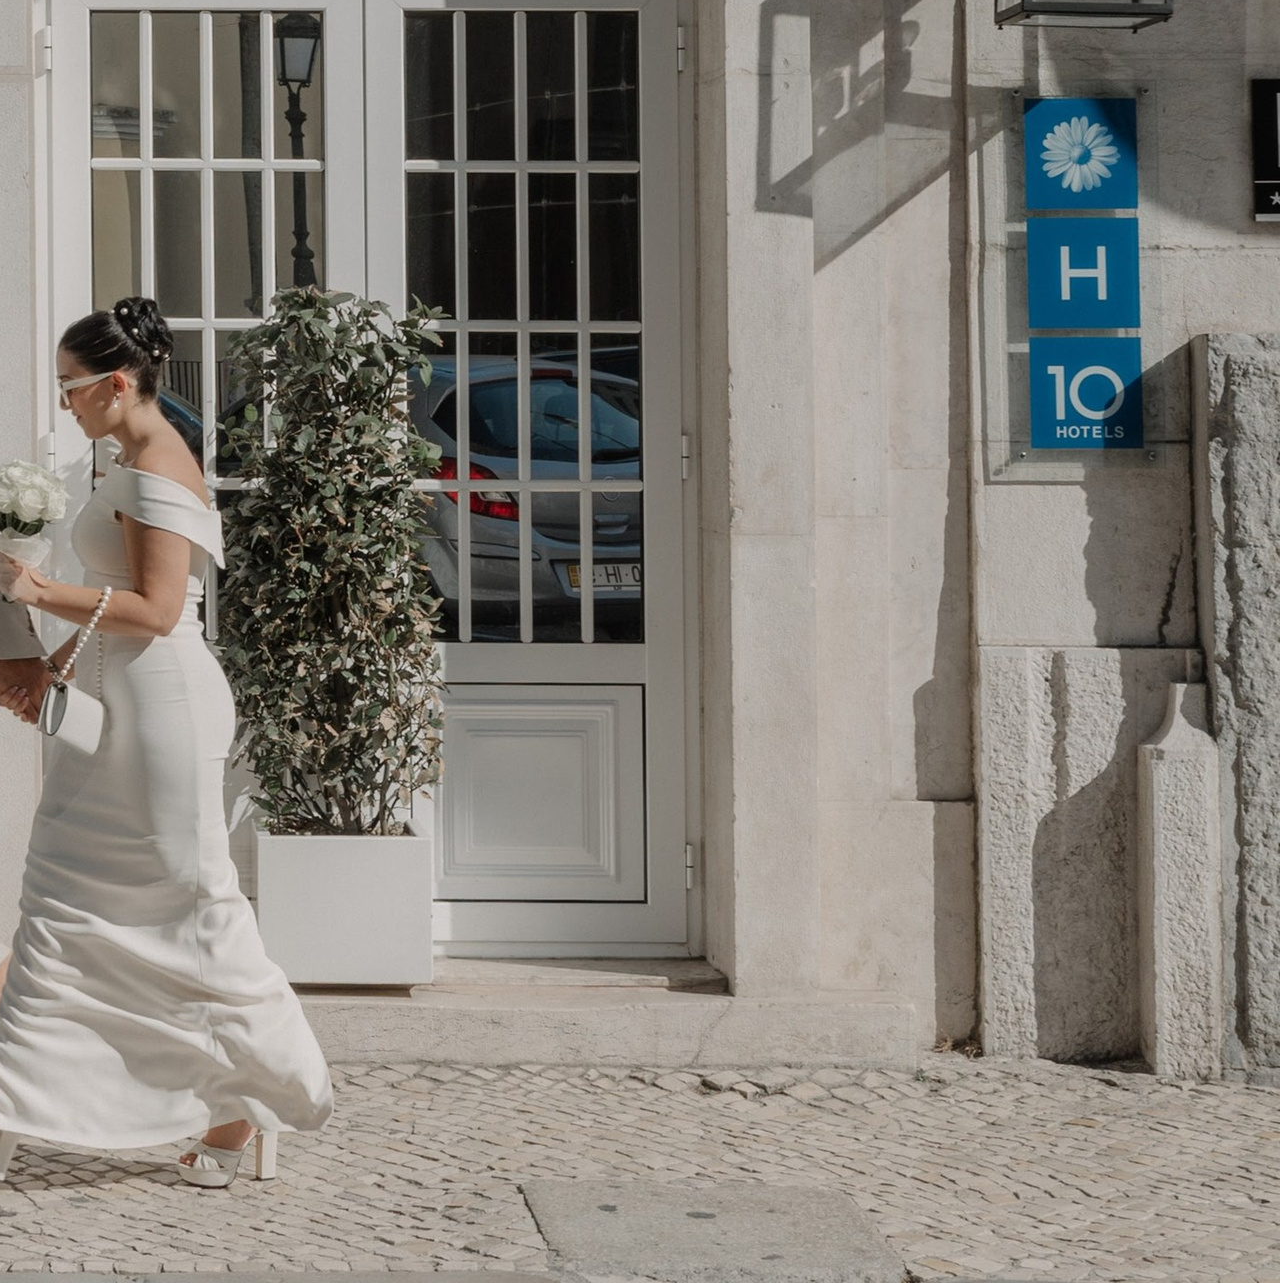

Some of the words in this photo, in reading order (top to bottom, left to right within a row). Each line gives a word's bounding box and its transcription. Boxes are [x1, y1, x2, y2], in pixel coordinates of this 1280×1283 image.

[1060, 245, 1107, 301] H
[1047, 365, 1124, 420] 10
[1056, 426, 1125, 438] HOTELS
